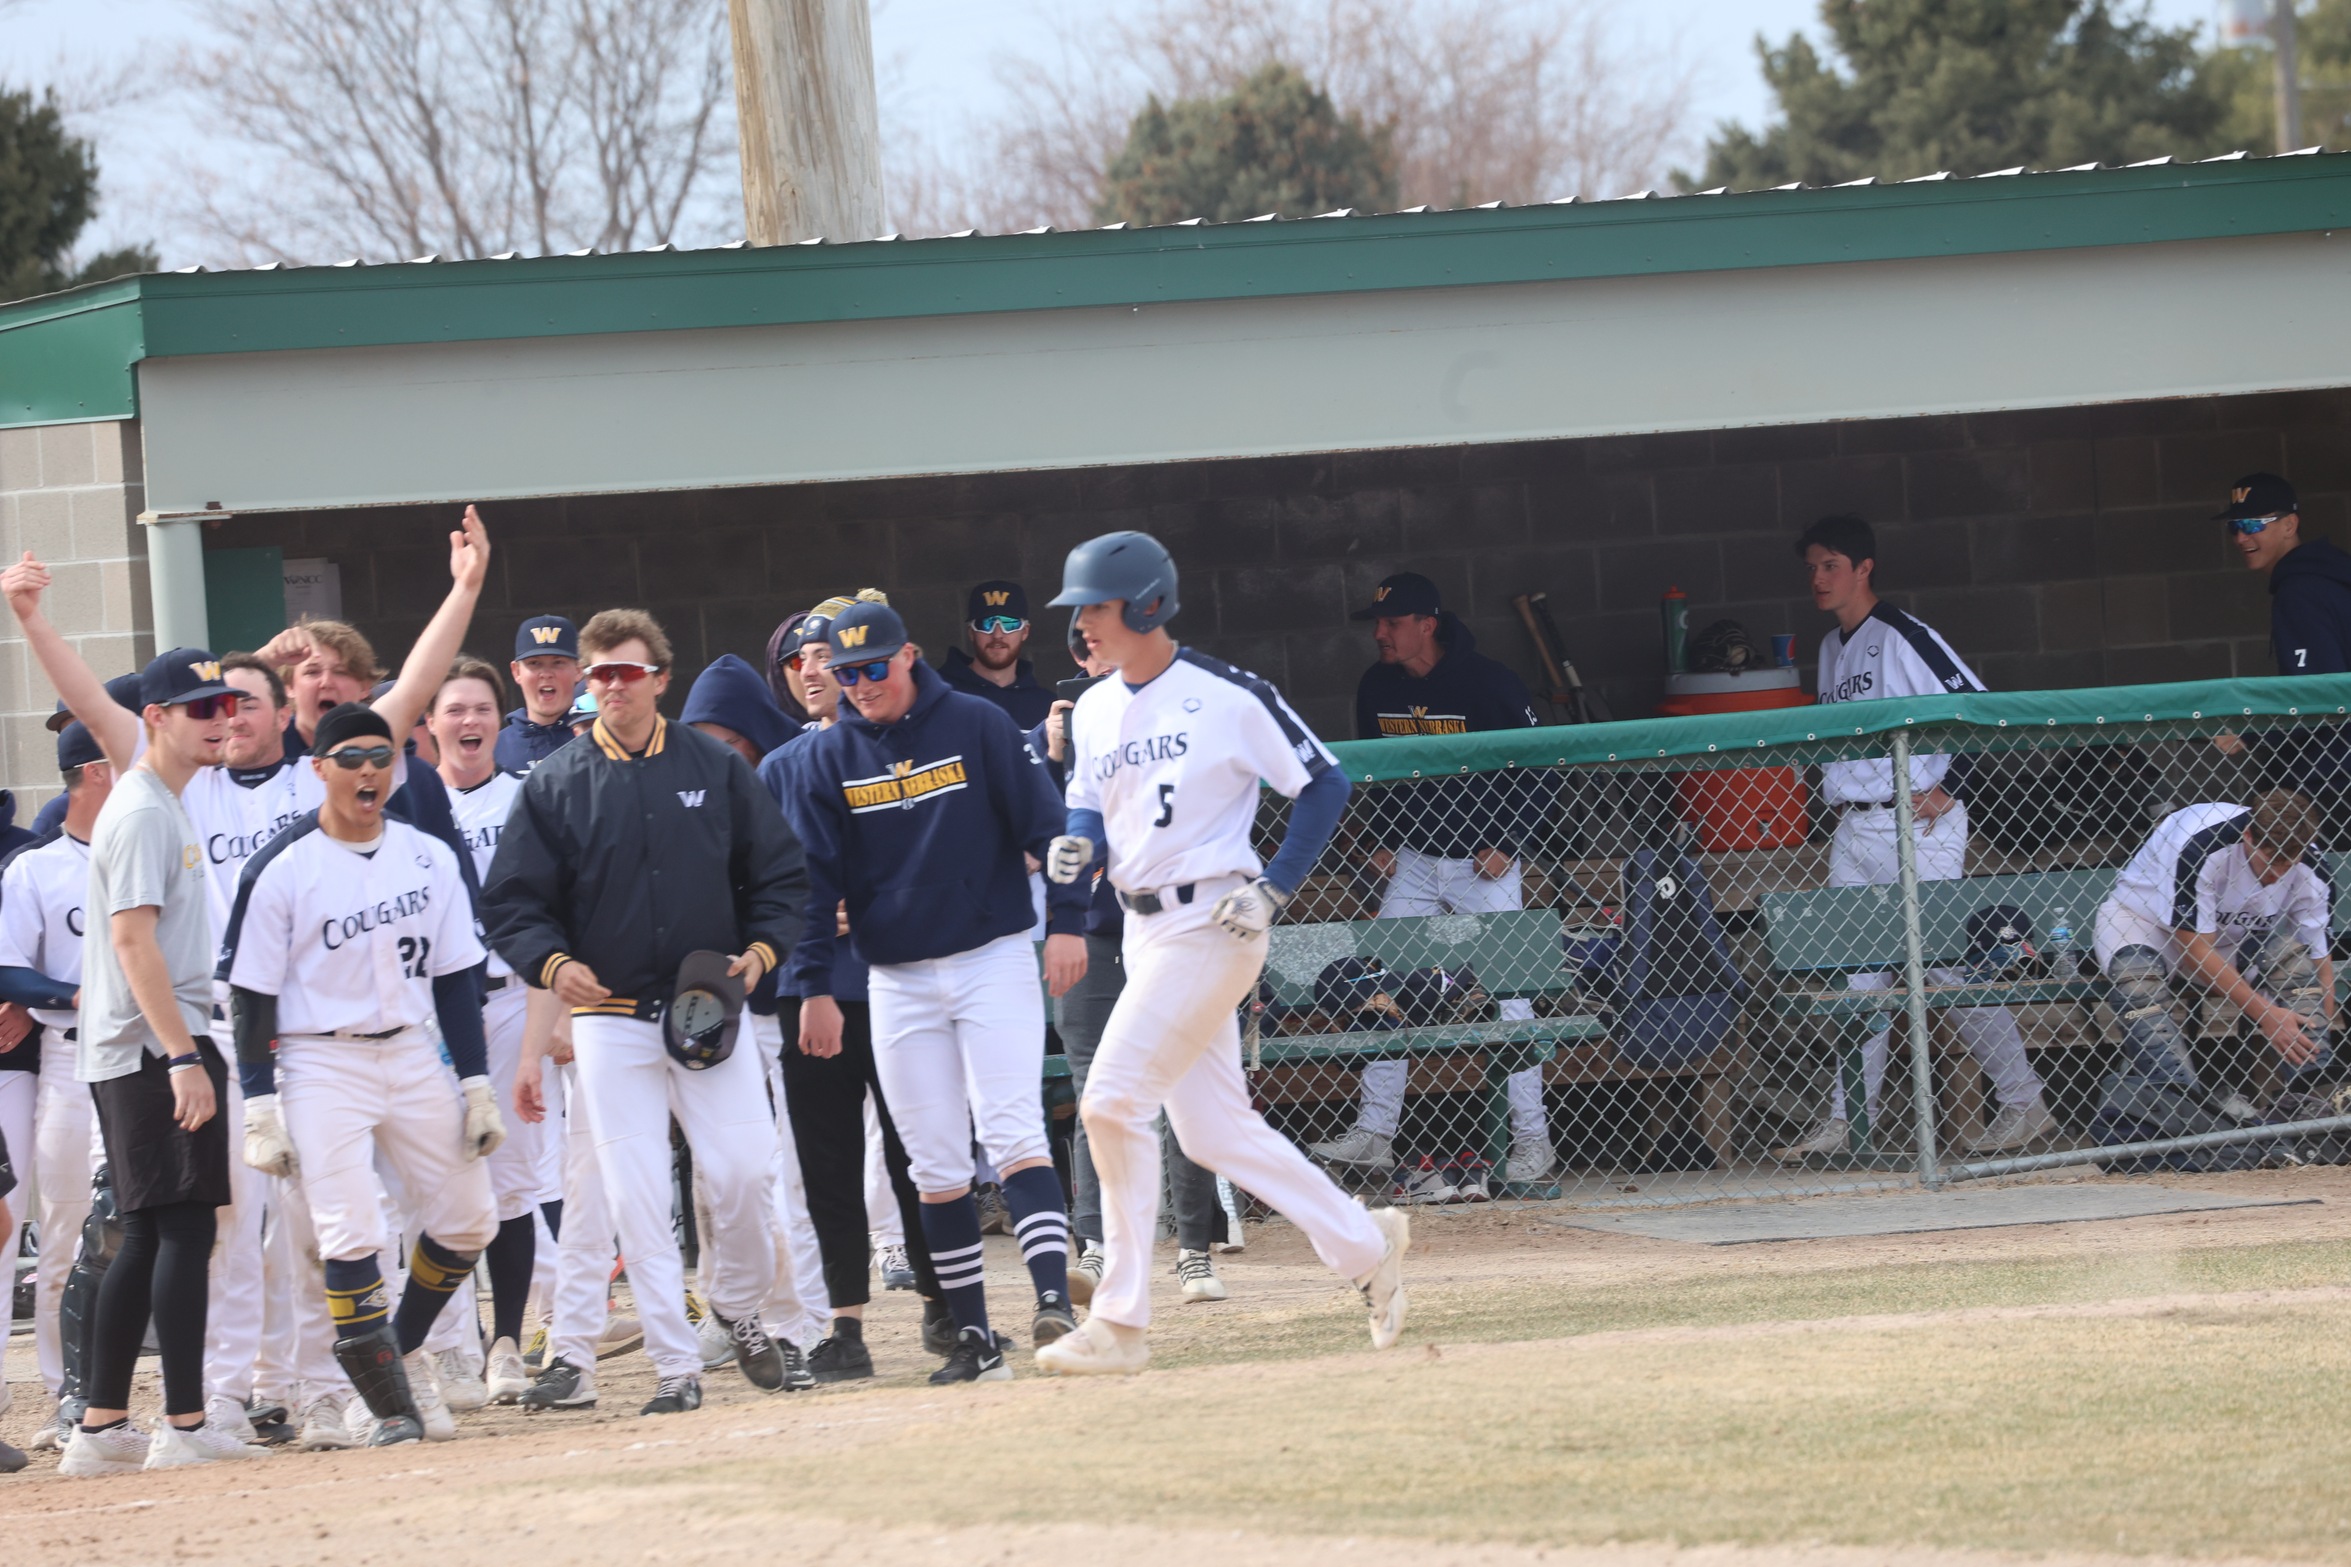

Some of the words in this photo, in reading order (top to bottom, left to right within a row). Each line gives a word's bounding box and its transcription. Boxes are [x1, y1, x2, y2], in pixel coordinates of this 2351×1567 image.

[982, 590, 1010, 606] W
[530, 627, 562, 644] W
[838, 625, 869, 649] W
[2295, 649, 2307, 667] 7
[189, 660, 221, 681] W
[1378, 718, 1418, 734] WESTERN
[1419, 719, 1467, 735] NEBRASKA
[676, 789, 707, 807] W
[1154, 783, 1174, 828] 5
[323, 886, 431, 950] COUGARS
